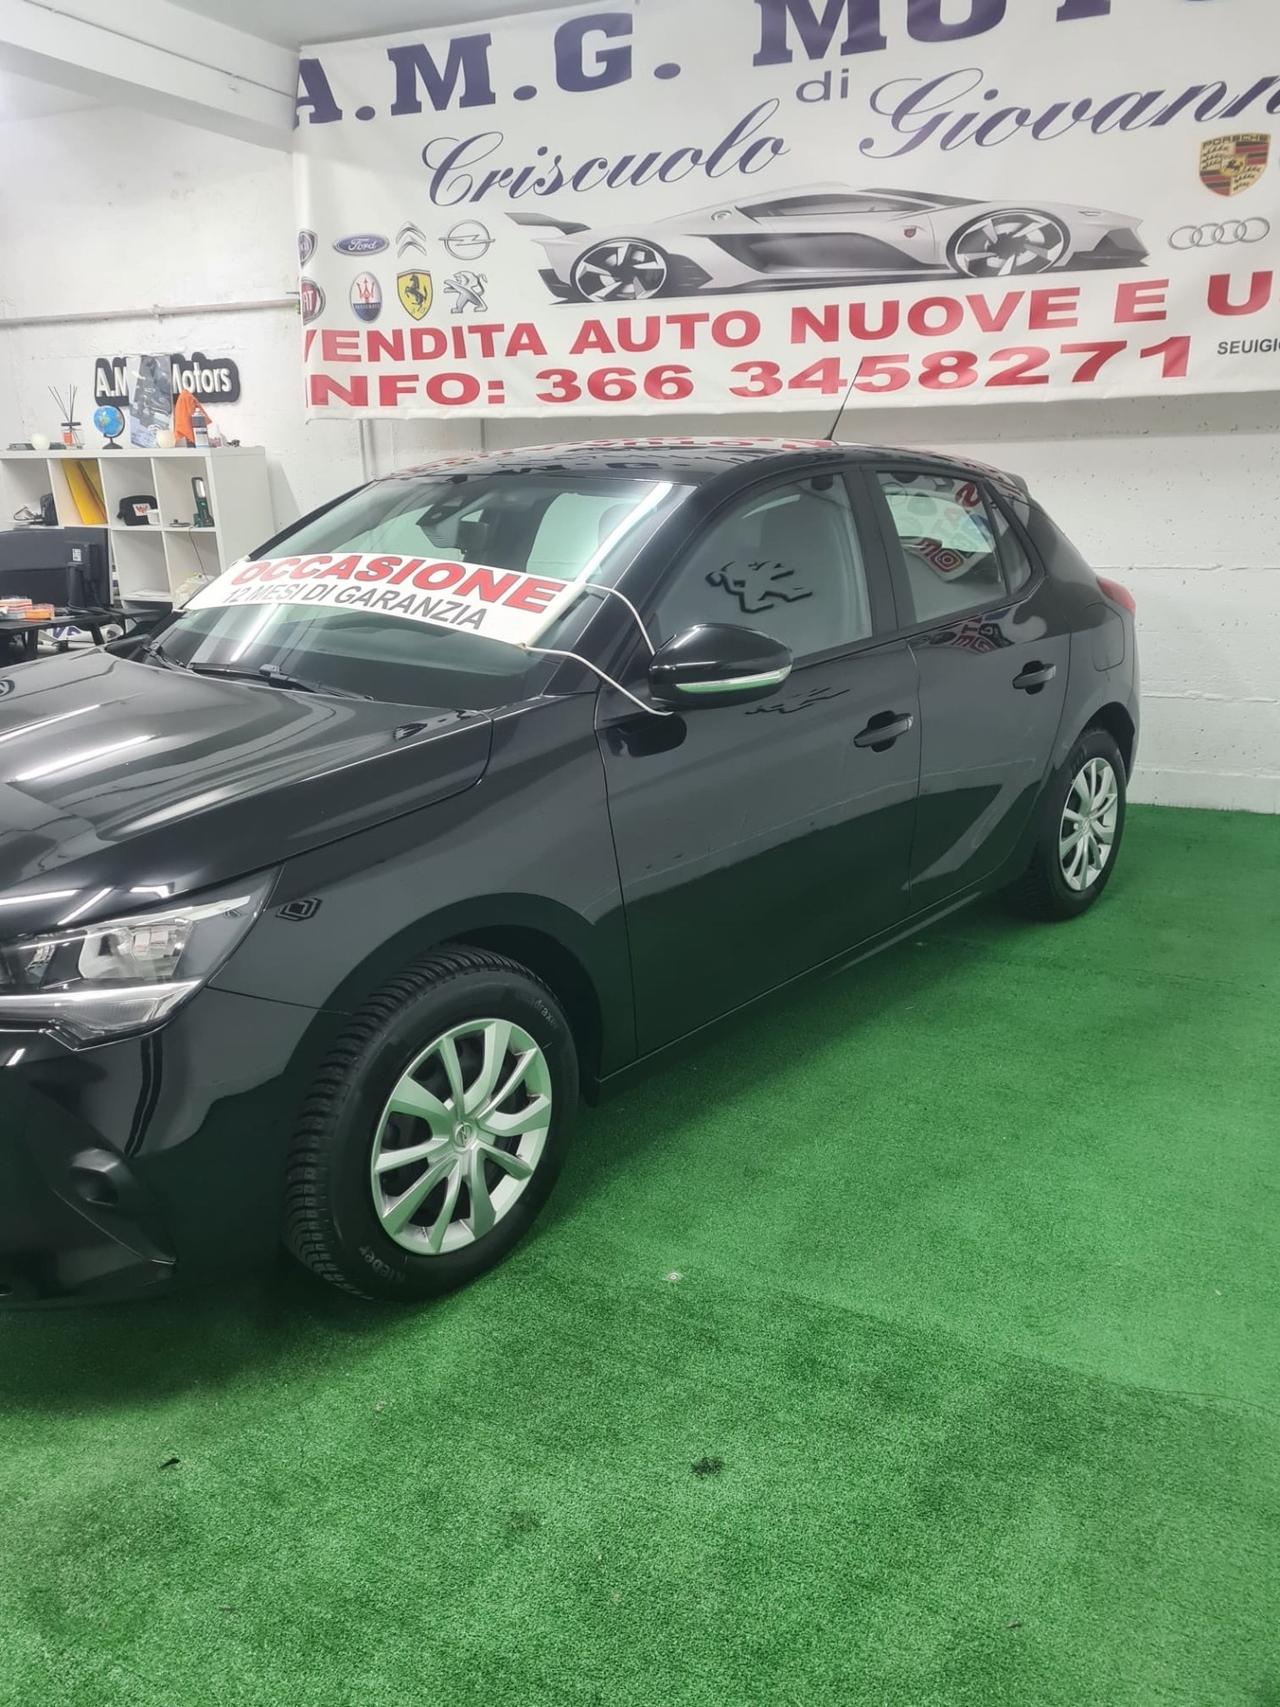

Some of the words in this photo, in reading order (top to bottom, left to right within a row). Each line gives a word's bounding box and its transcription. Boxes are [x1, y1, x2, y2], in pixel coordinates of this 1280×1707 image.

[294, 12, 682, 131] A.M.G.
[795, 67, 850, 103] di
[421, 95, 791, 207] Criscuolo
[347, 238, 378, 251] Ford
[570, 309, 761, 356] AUTO
[789, 286, 1081, 345] NUOVE
[1113, 278, 1170, 325] E
[1217, 337, 1280, 356] SEUIGI
[305, 371, 504, 408] NFO:
[535, 363, 695, 405] 366
[729, 335, 1191, 400] 3458271
[223, 586, 252, 603] 12
[246, 583, 308, 602] MESI
[300, 583, 338, 602] DI
[334, 585, 488, 630] GARANZIA
[231, 554, 566, 614] OCCASIONE
